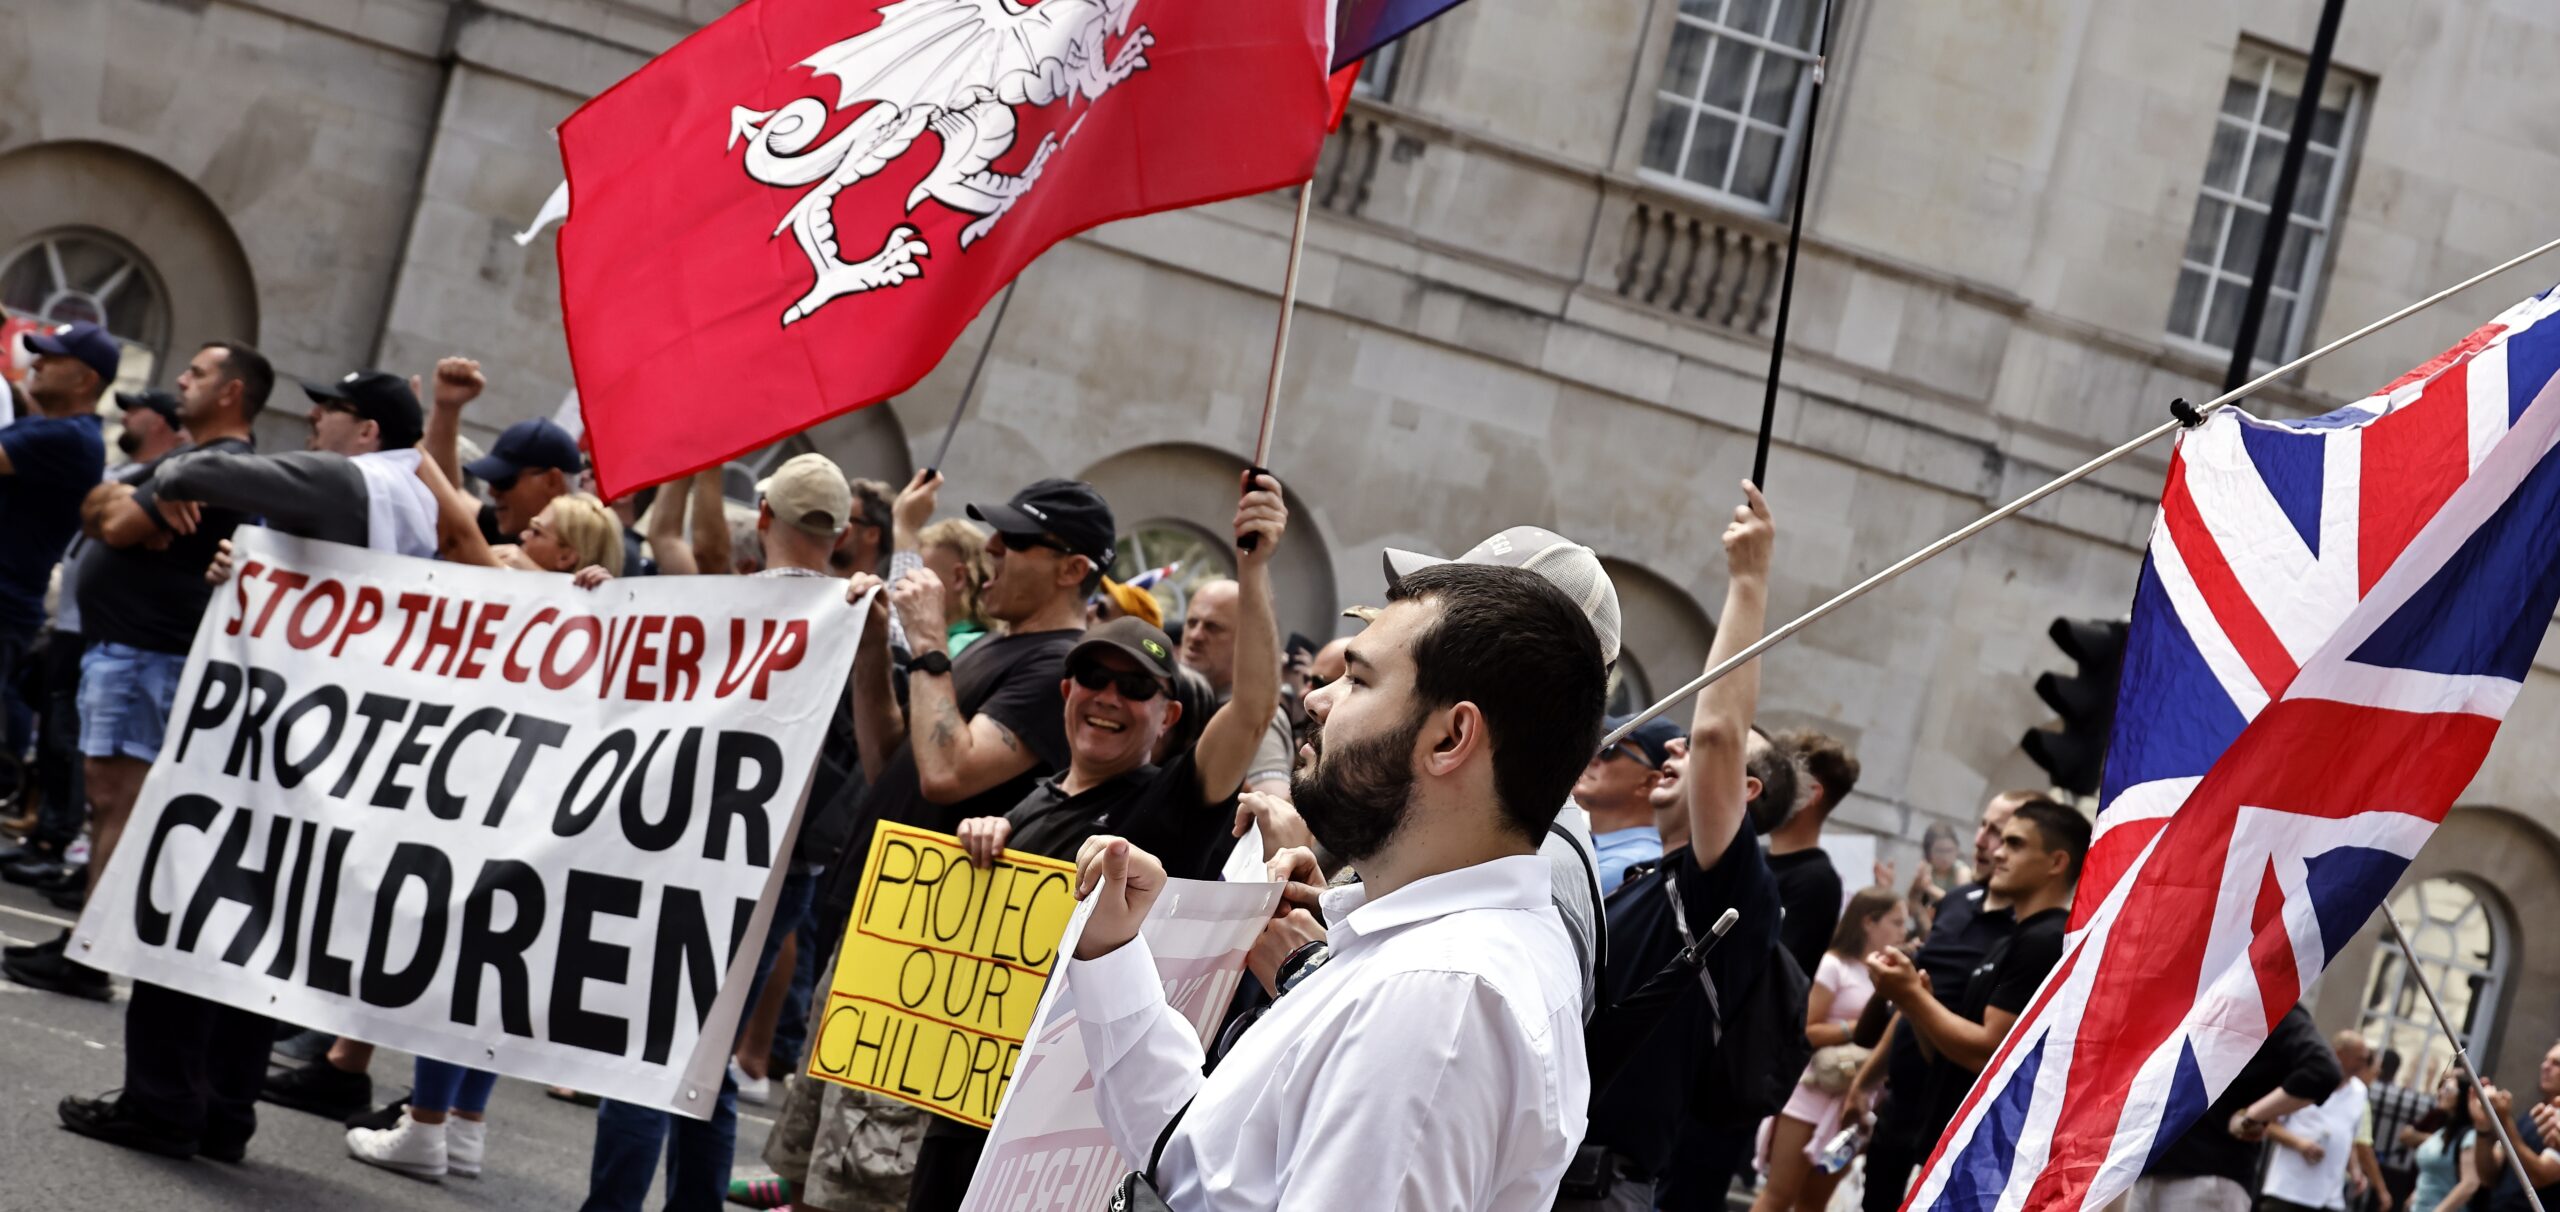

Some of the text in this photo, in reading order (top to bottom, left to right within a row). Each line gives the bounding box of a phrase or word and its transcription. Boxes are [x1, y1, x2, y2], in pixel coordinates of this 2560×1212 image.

[225, 561, 809, 702] STOP THE COVER UP
[176, 661, 783, 868] PROTECT OUR
[136, 795, 757, 1066] CHILDREN
[864, 839, 1069, 967] PROTEC
[899, 949, 1012, 1028] OUR
[816, 1005, 1022, 1120] CHILDRE
